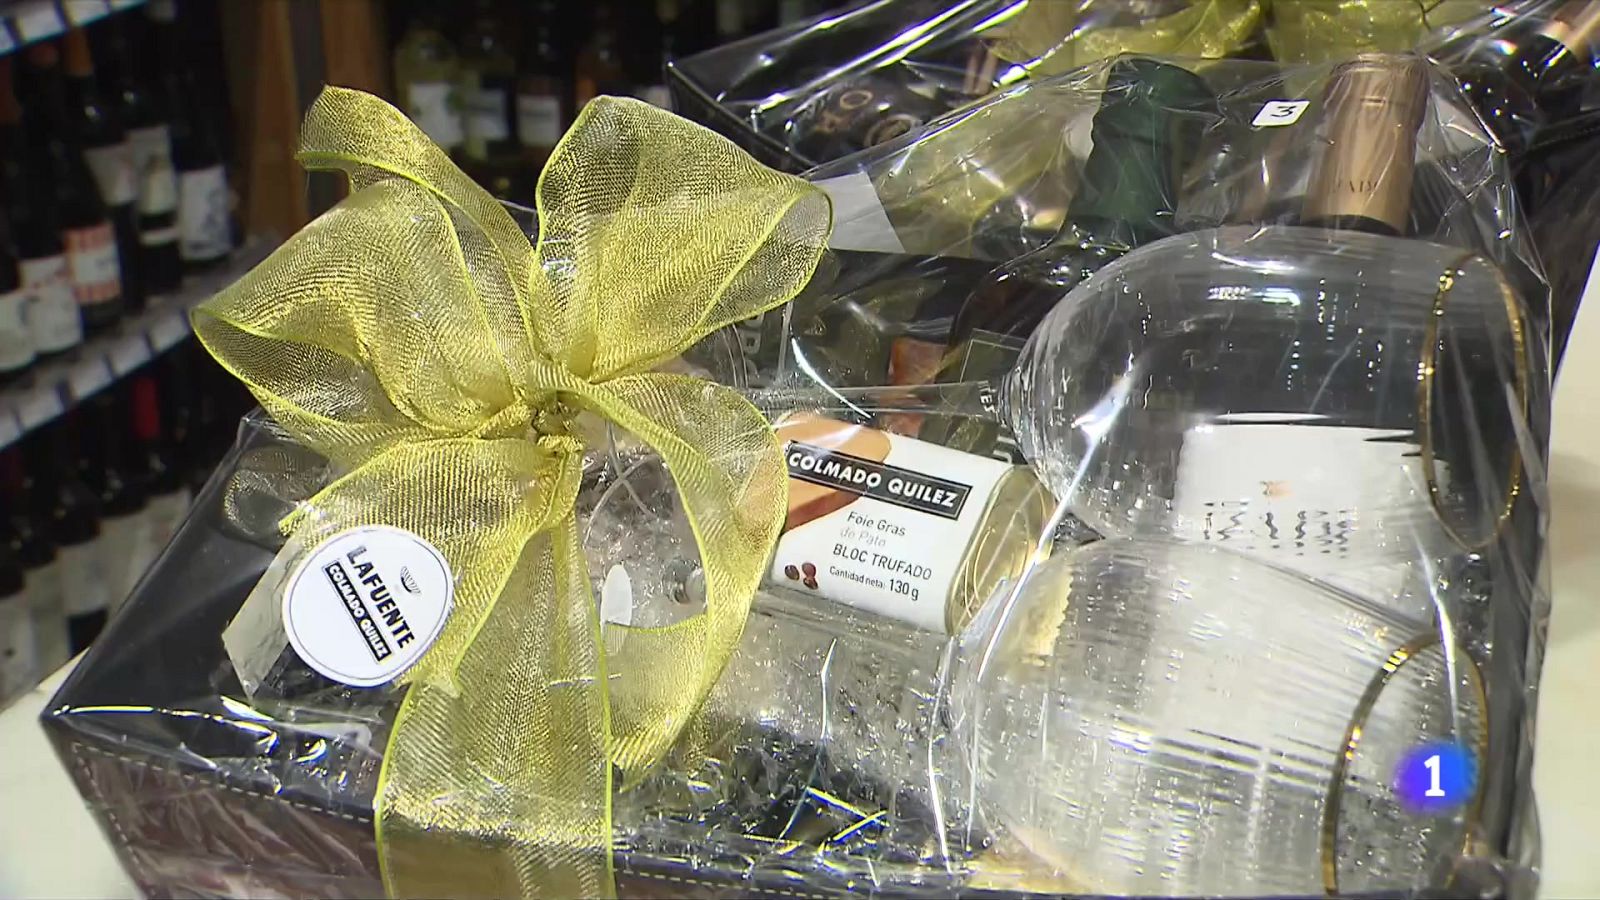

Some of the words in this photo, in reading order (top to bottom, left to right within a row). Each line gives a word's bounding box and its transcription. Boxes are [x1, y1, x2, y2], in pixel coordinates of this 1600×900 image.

[1270, 105, 1297, 118] 3
[788, 451, 882, 489] COLMADO
[887, 477, 959, 508] QUILEZ
[840, 527, 856, 539] de
[859, 530, 887, 547] Pato
[847, 511, 875, 528] Foie
[876, 519, 906, 537] Gras
[832, 543, 869, 563] BLOC
[871, 552, 932, 581] TRUFADO
[346, 545, 415, 650] LAFUENTE
[829, 565, 865, 584] Cantidad
[865, 576, 886, 590] neta:
[889, 578, 910, 595] 130
[911, 588, 919, 601] g
[328, 564, 365, 617] COLMADO
[359, 619, 391, 661] QUILEZ
